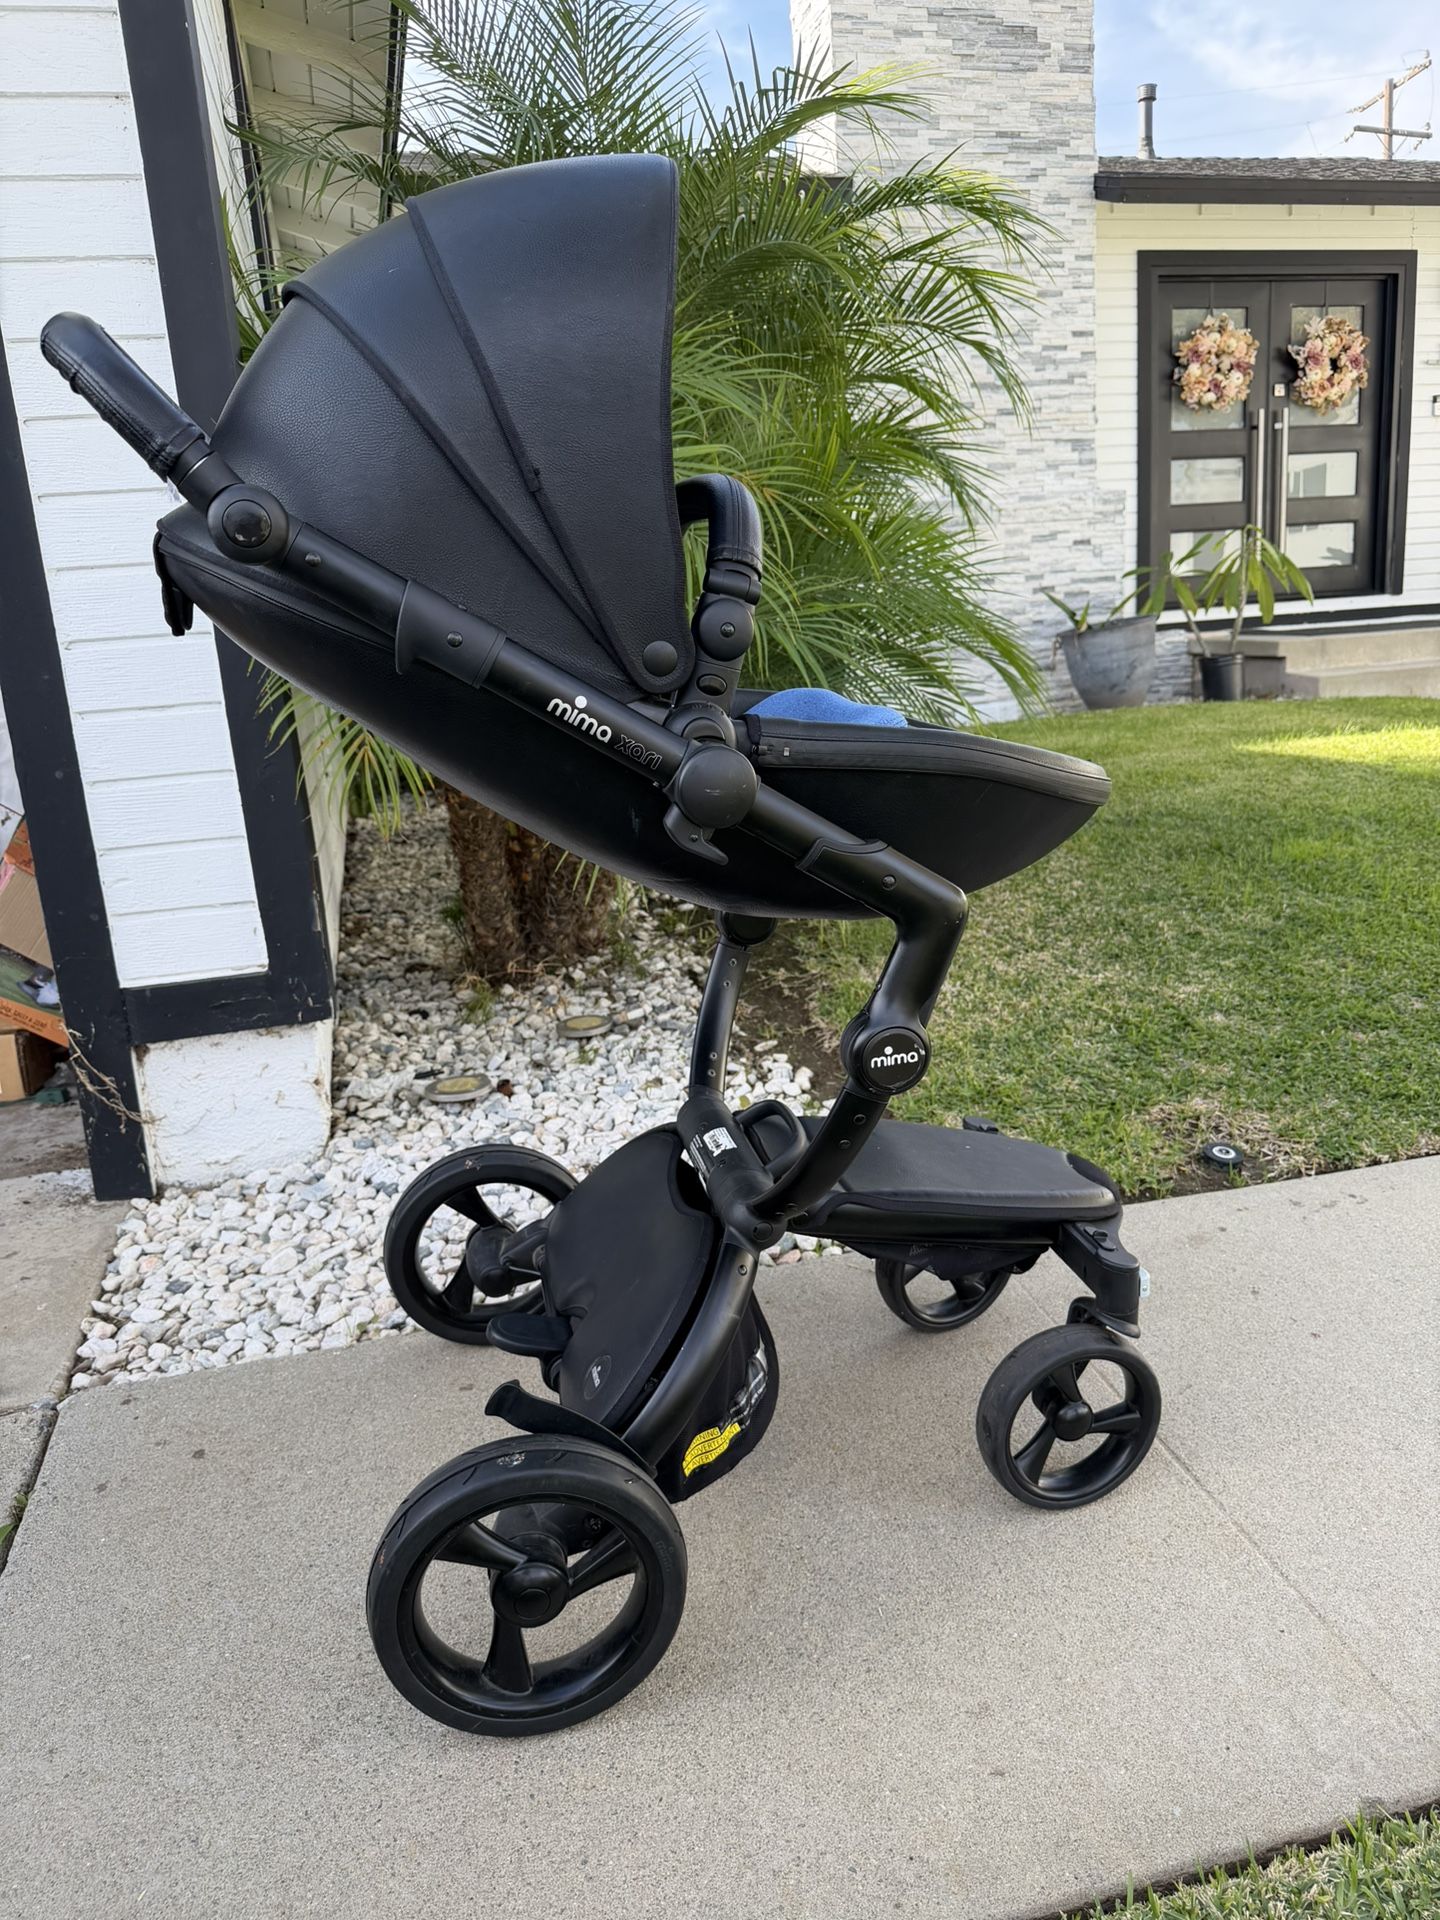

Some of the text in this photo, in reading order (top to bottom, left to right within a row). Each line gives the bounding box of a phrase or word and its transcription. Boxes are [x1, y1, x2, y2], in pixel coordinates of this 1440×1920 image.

[546, 696, 663, 770] mima xari
[870, 1046, 919, 1069] mima
